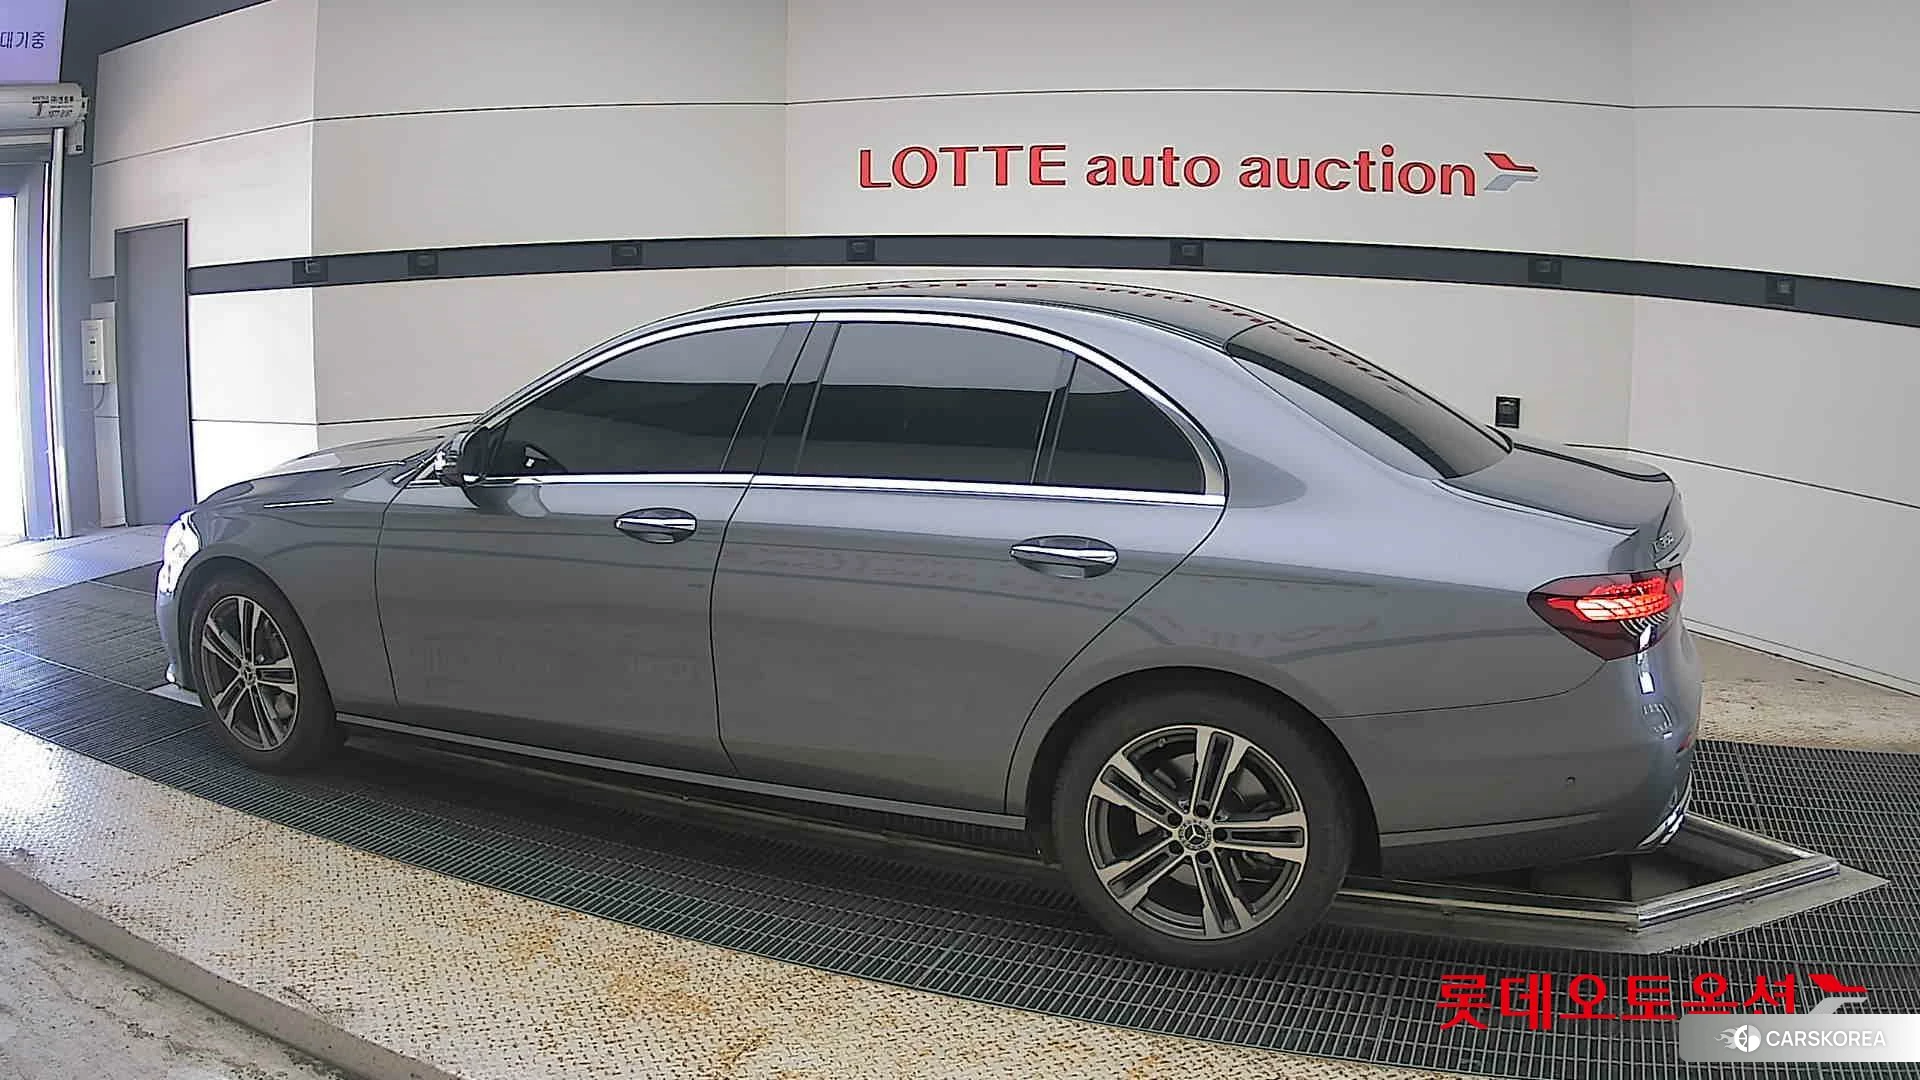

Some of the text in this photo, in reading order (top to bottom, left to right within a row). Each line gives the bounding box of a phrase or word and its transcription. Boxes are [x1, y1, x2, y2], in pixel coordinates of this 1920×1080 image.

[0, 31, 45, 49] 대기중
[859, 145, 1477, 196] LOTTE auto auction
